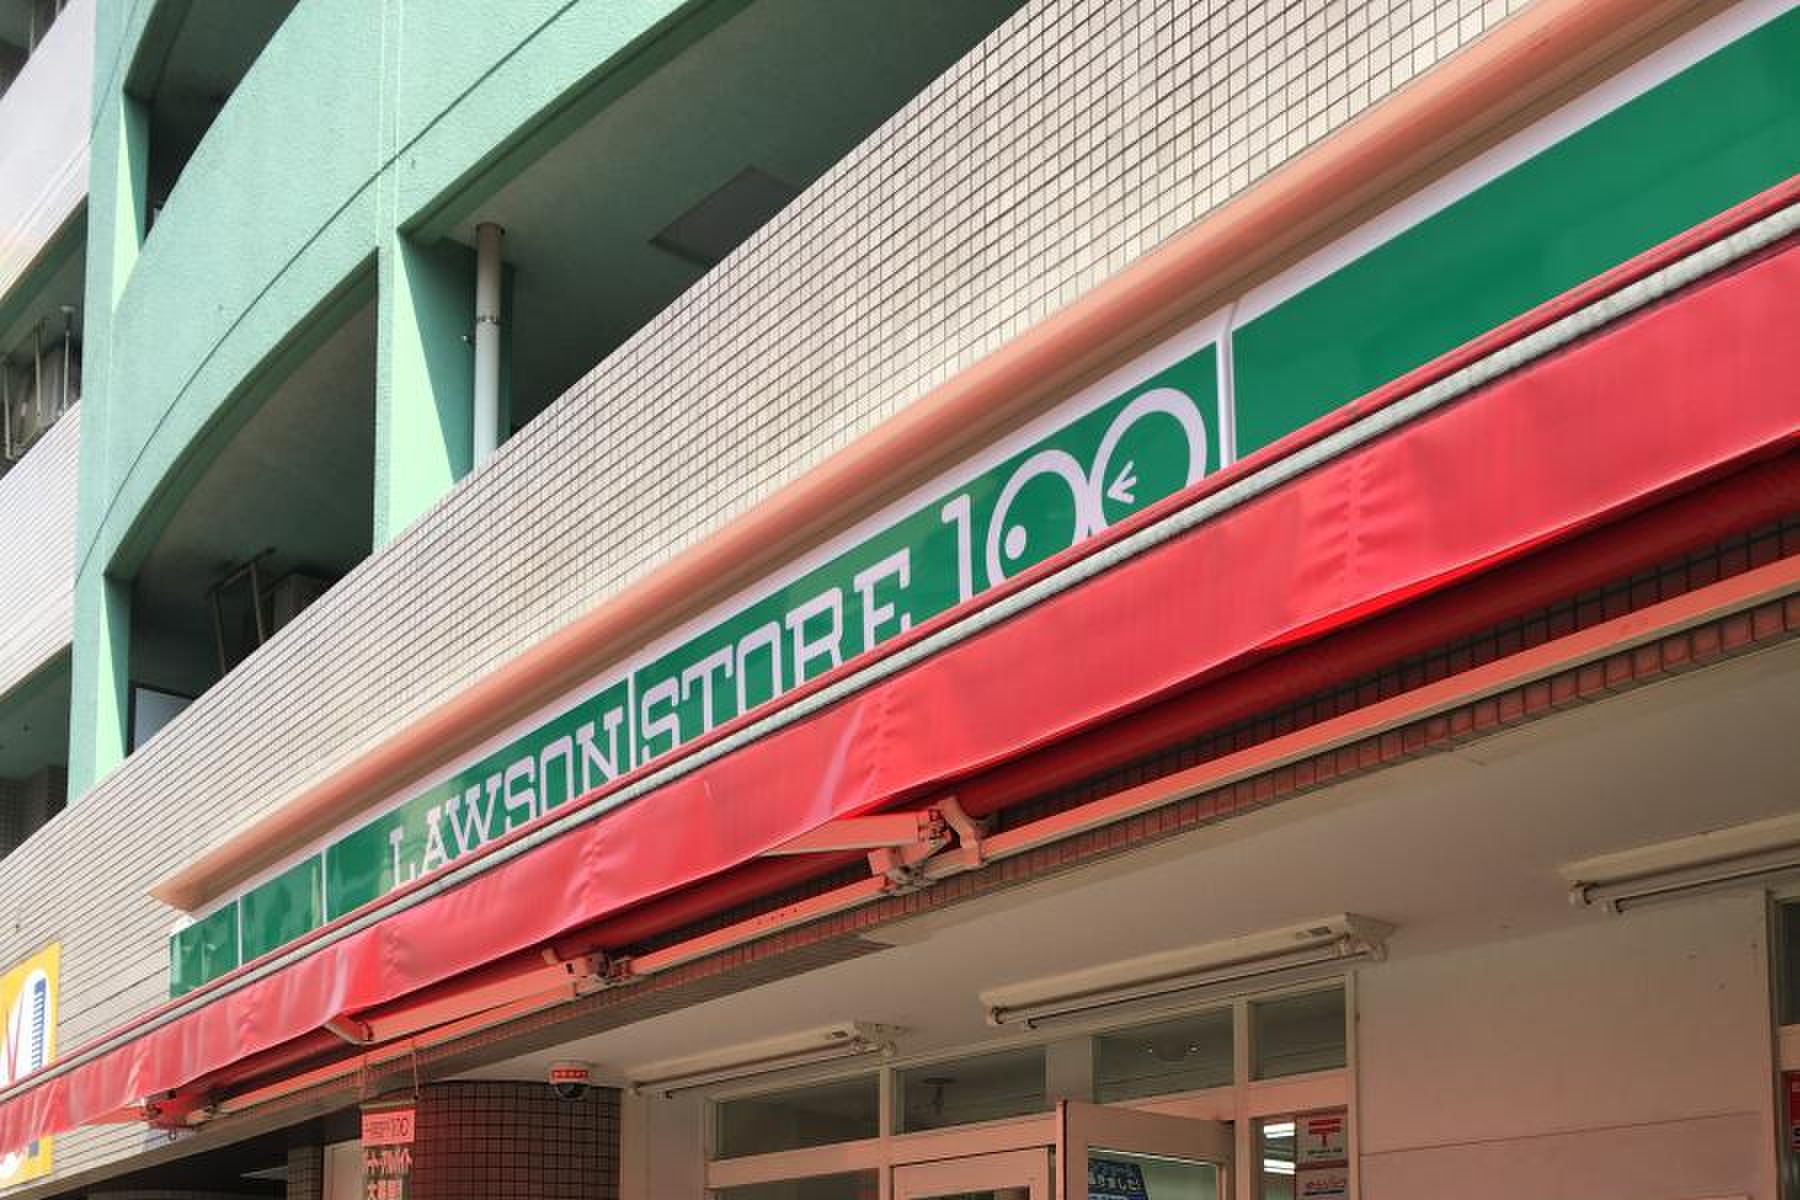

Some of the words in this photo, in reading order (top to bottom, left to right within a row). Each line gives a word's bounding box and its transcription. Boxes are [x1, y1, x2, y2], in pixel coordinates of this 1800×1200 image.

[390, 710, 624, 889] LAWSON
[641, 547, 911, 760] STORE
[942, 387, 1208, 603] 100
